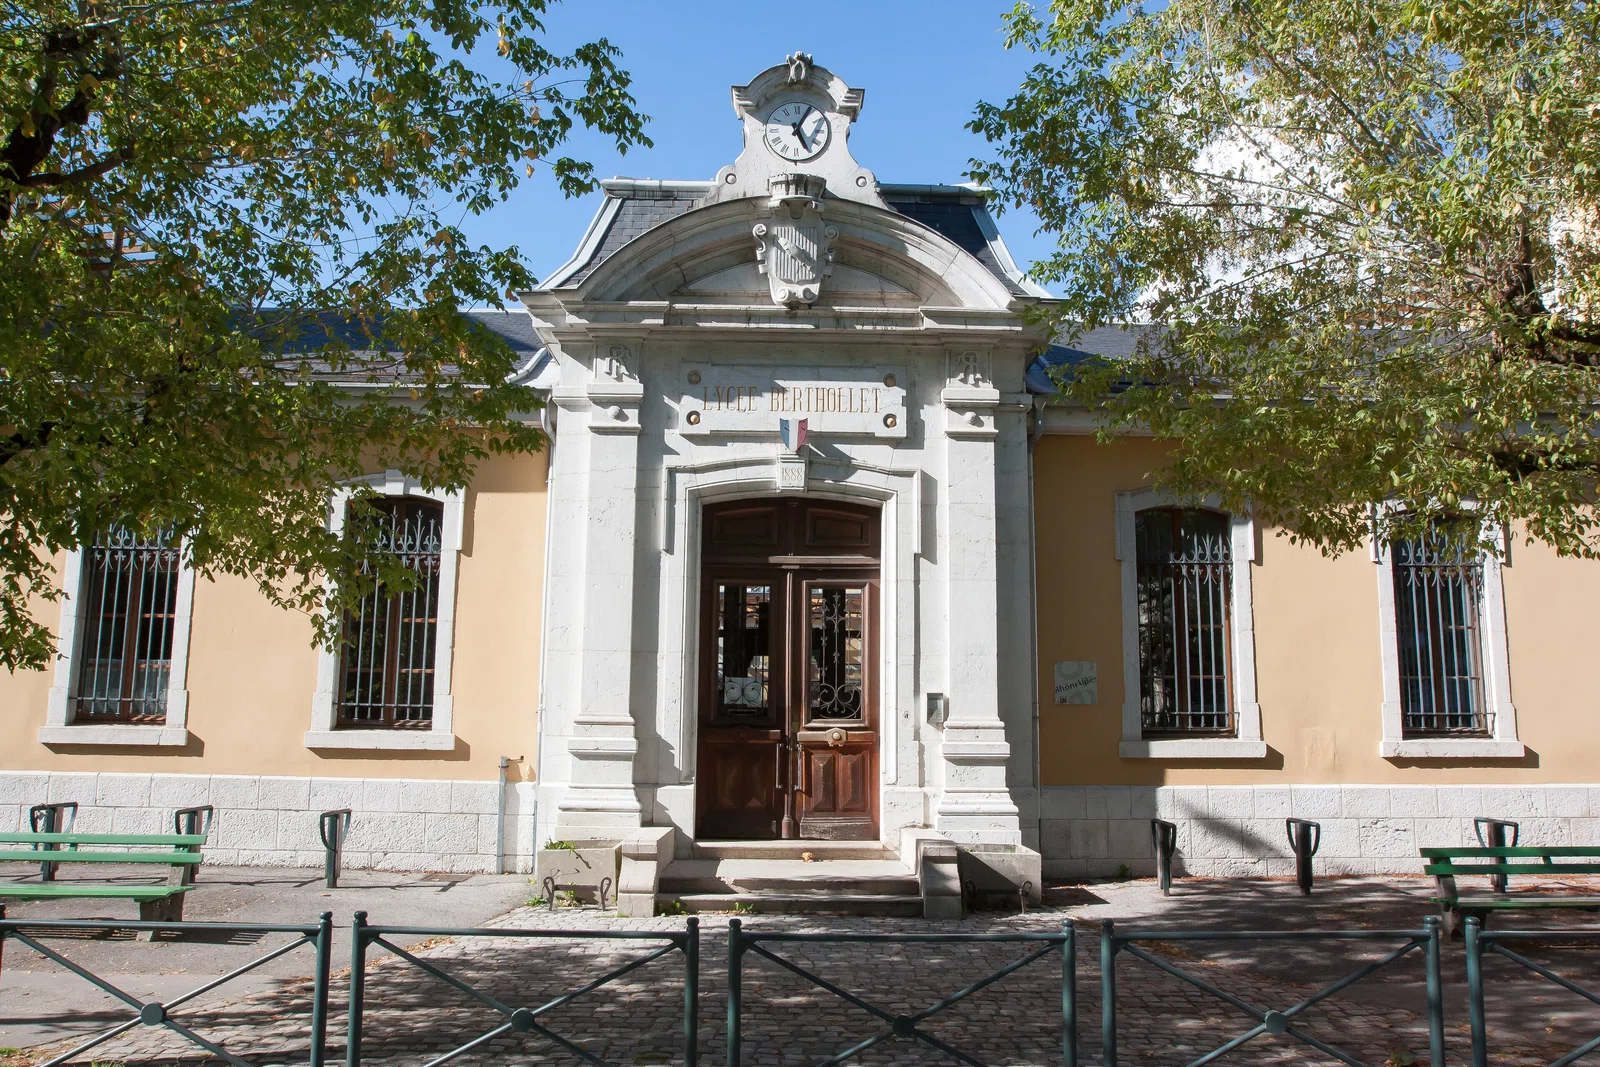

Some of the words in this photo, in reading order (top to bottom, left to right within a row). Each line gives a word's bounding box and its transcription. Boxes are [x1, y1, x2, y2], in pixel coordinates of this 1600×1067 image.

[703, 386, 758, 412] LYCEE
[770, 386, 882, 413] BERTHOLLET
[781, 467, 803, 481] 1888
